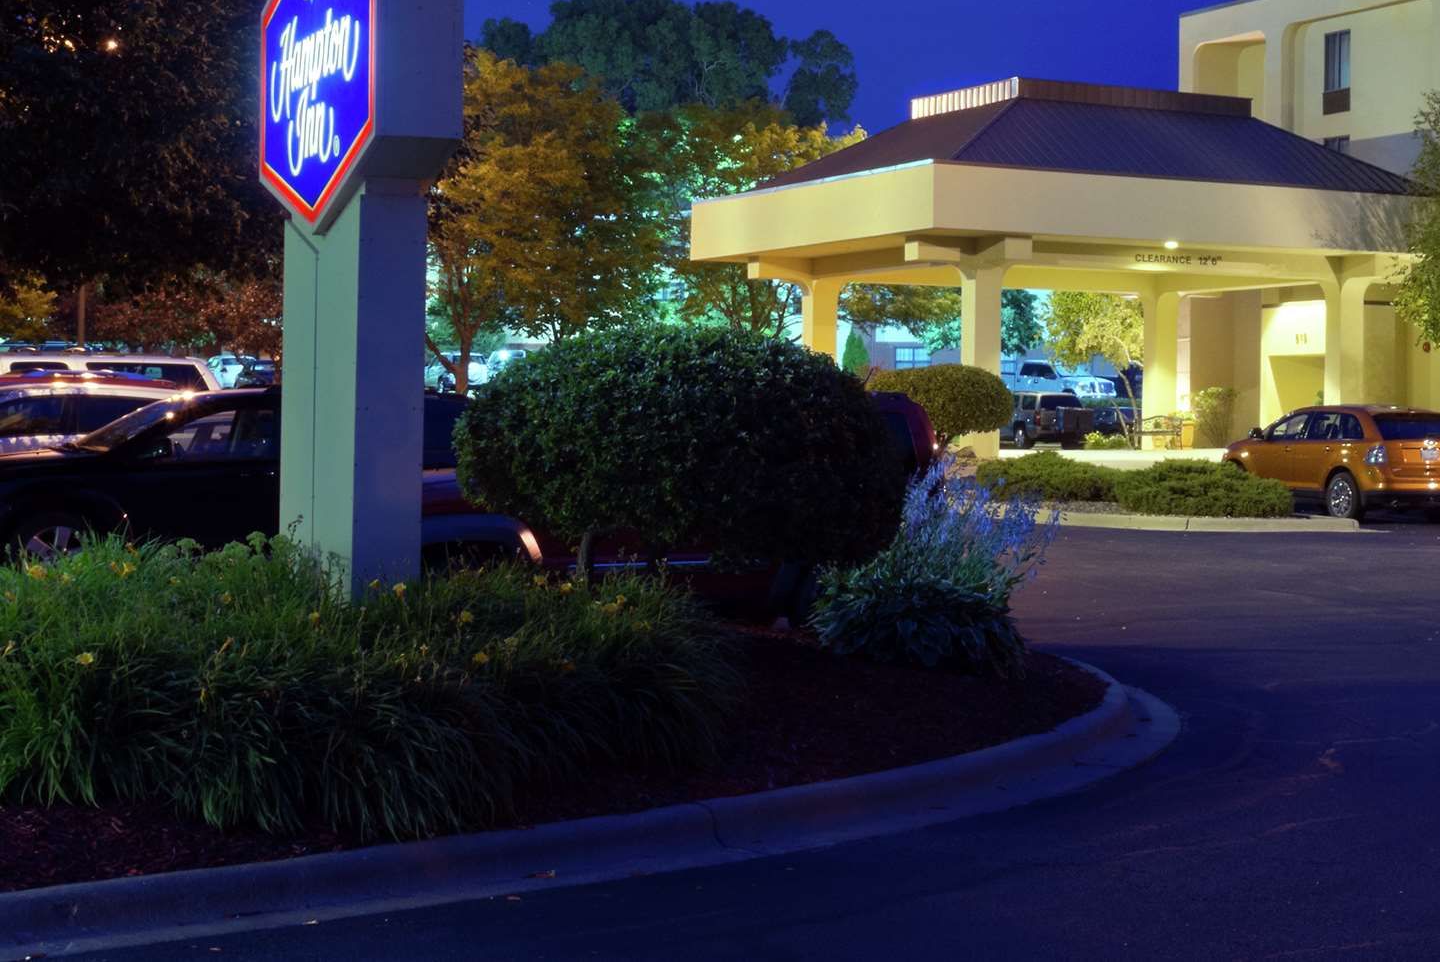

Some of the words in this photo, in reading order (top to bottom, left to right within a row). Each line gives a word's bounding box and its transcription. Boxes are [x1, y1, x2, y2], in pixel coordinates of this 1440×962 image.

[271, 8, 360, 122] Hampton
[288, 90, 334, 176] Inn
[1135, 253, 1192, 265] CLEARANCE
